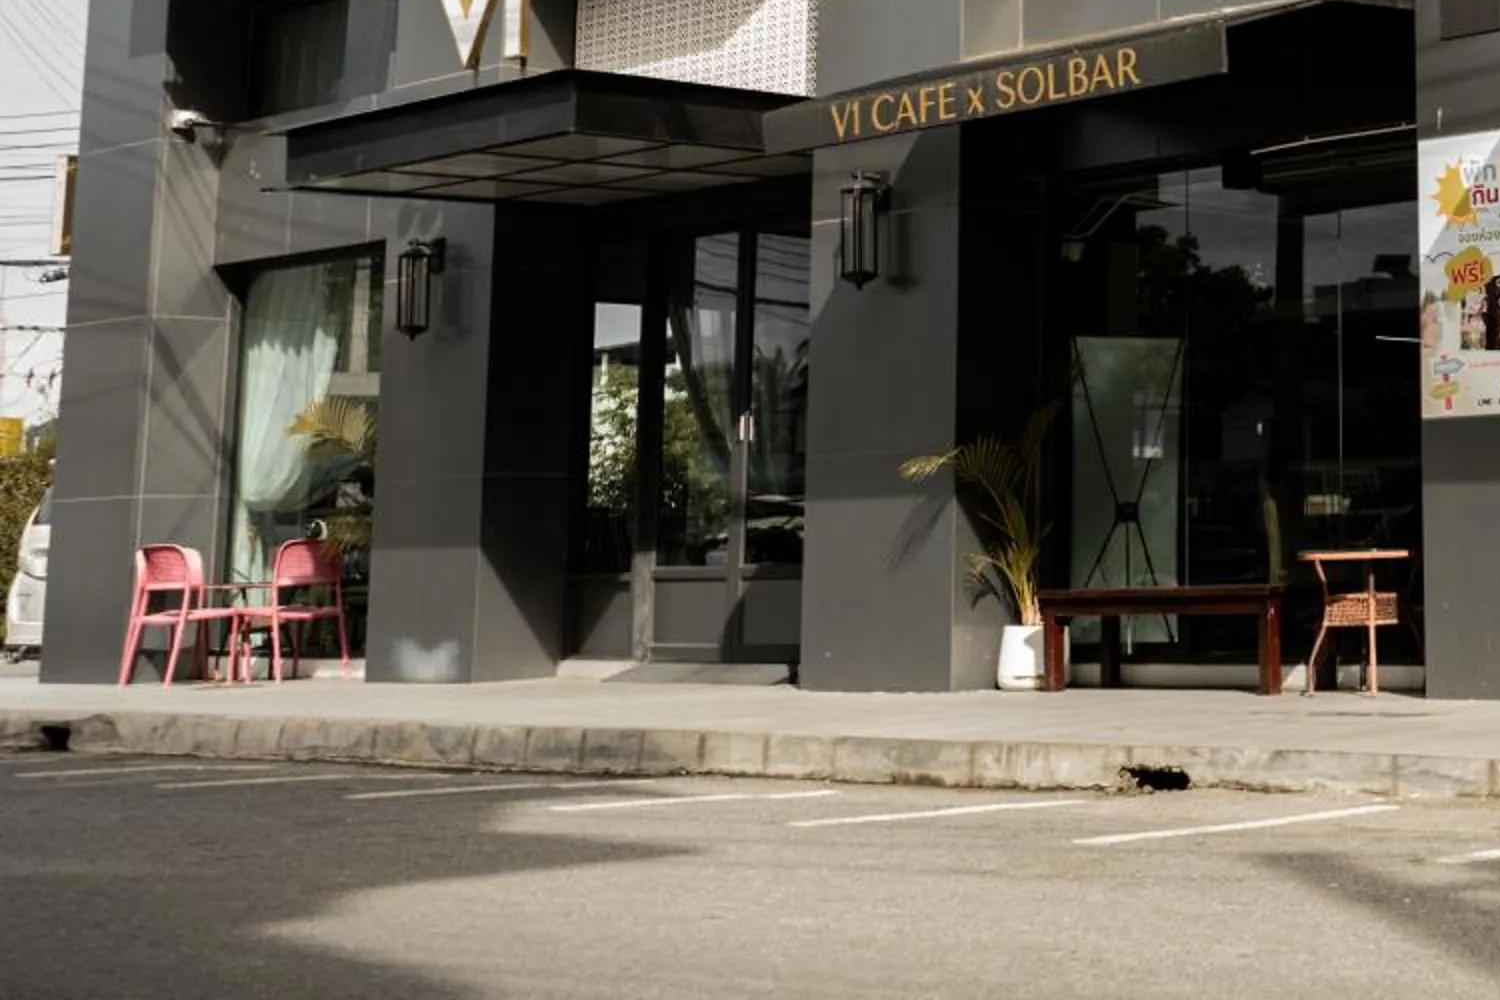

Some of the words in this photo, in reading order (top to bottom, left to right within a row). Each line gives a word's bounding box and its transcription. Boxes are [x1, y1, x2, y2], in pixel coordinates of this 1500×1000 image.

[831, 101, 861, 143] V1
[870, 82, 957, 133] CAFE
[995, 47, 1141, 110] SOLBAR
